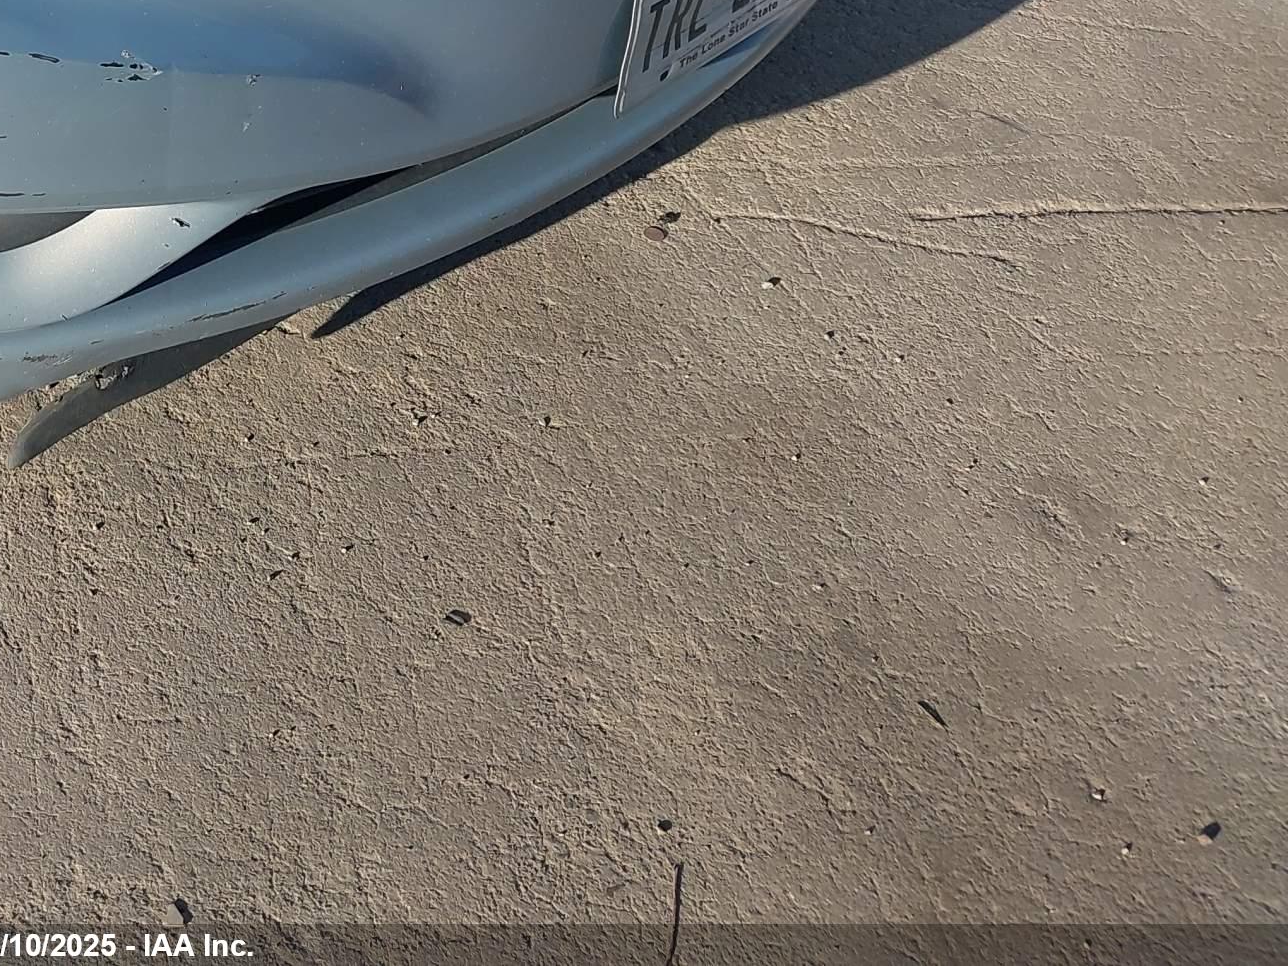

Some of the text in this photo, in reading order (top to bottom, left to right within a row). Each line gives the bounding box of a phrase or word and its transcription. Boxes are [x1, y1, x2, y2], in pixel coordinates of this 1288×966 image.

[680, 1, 779, 68] The Lone Star State
